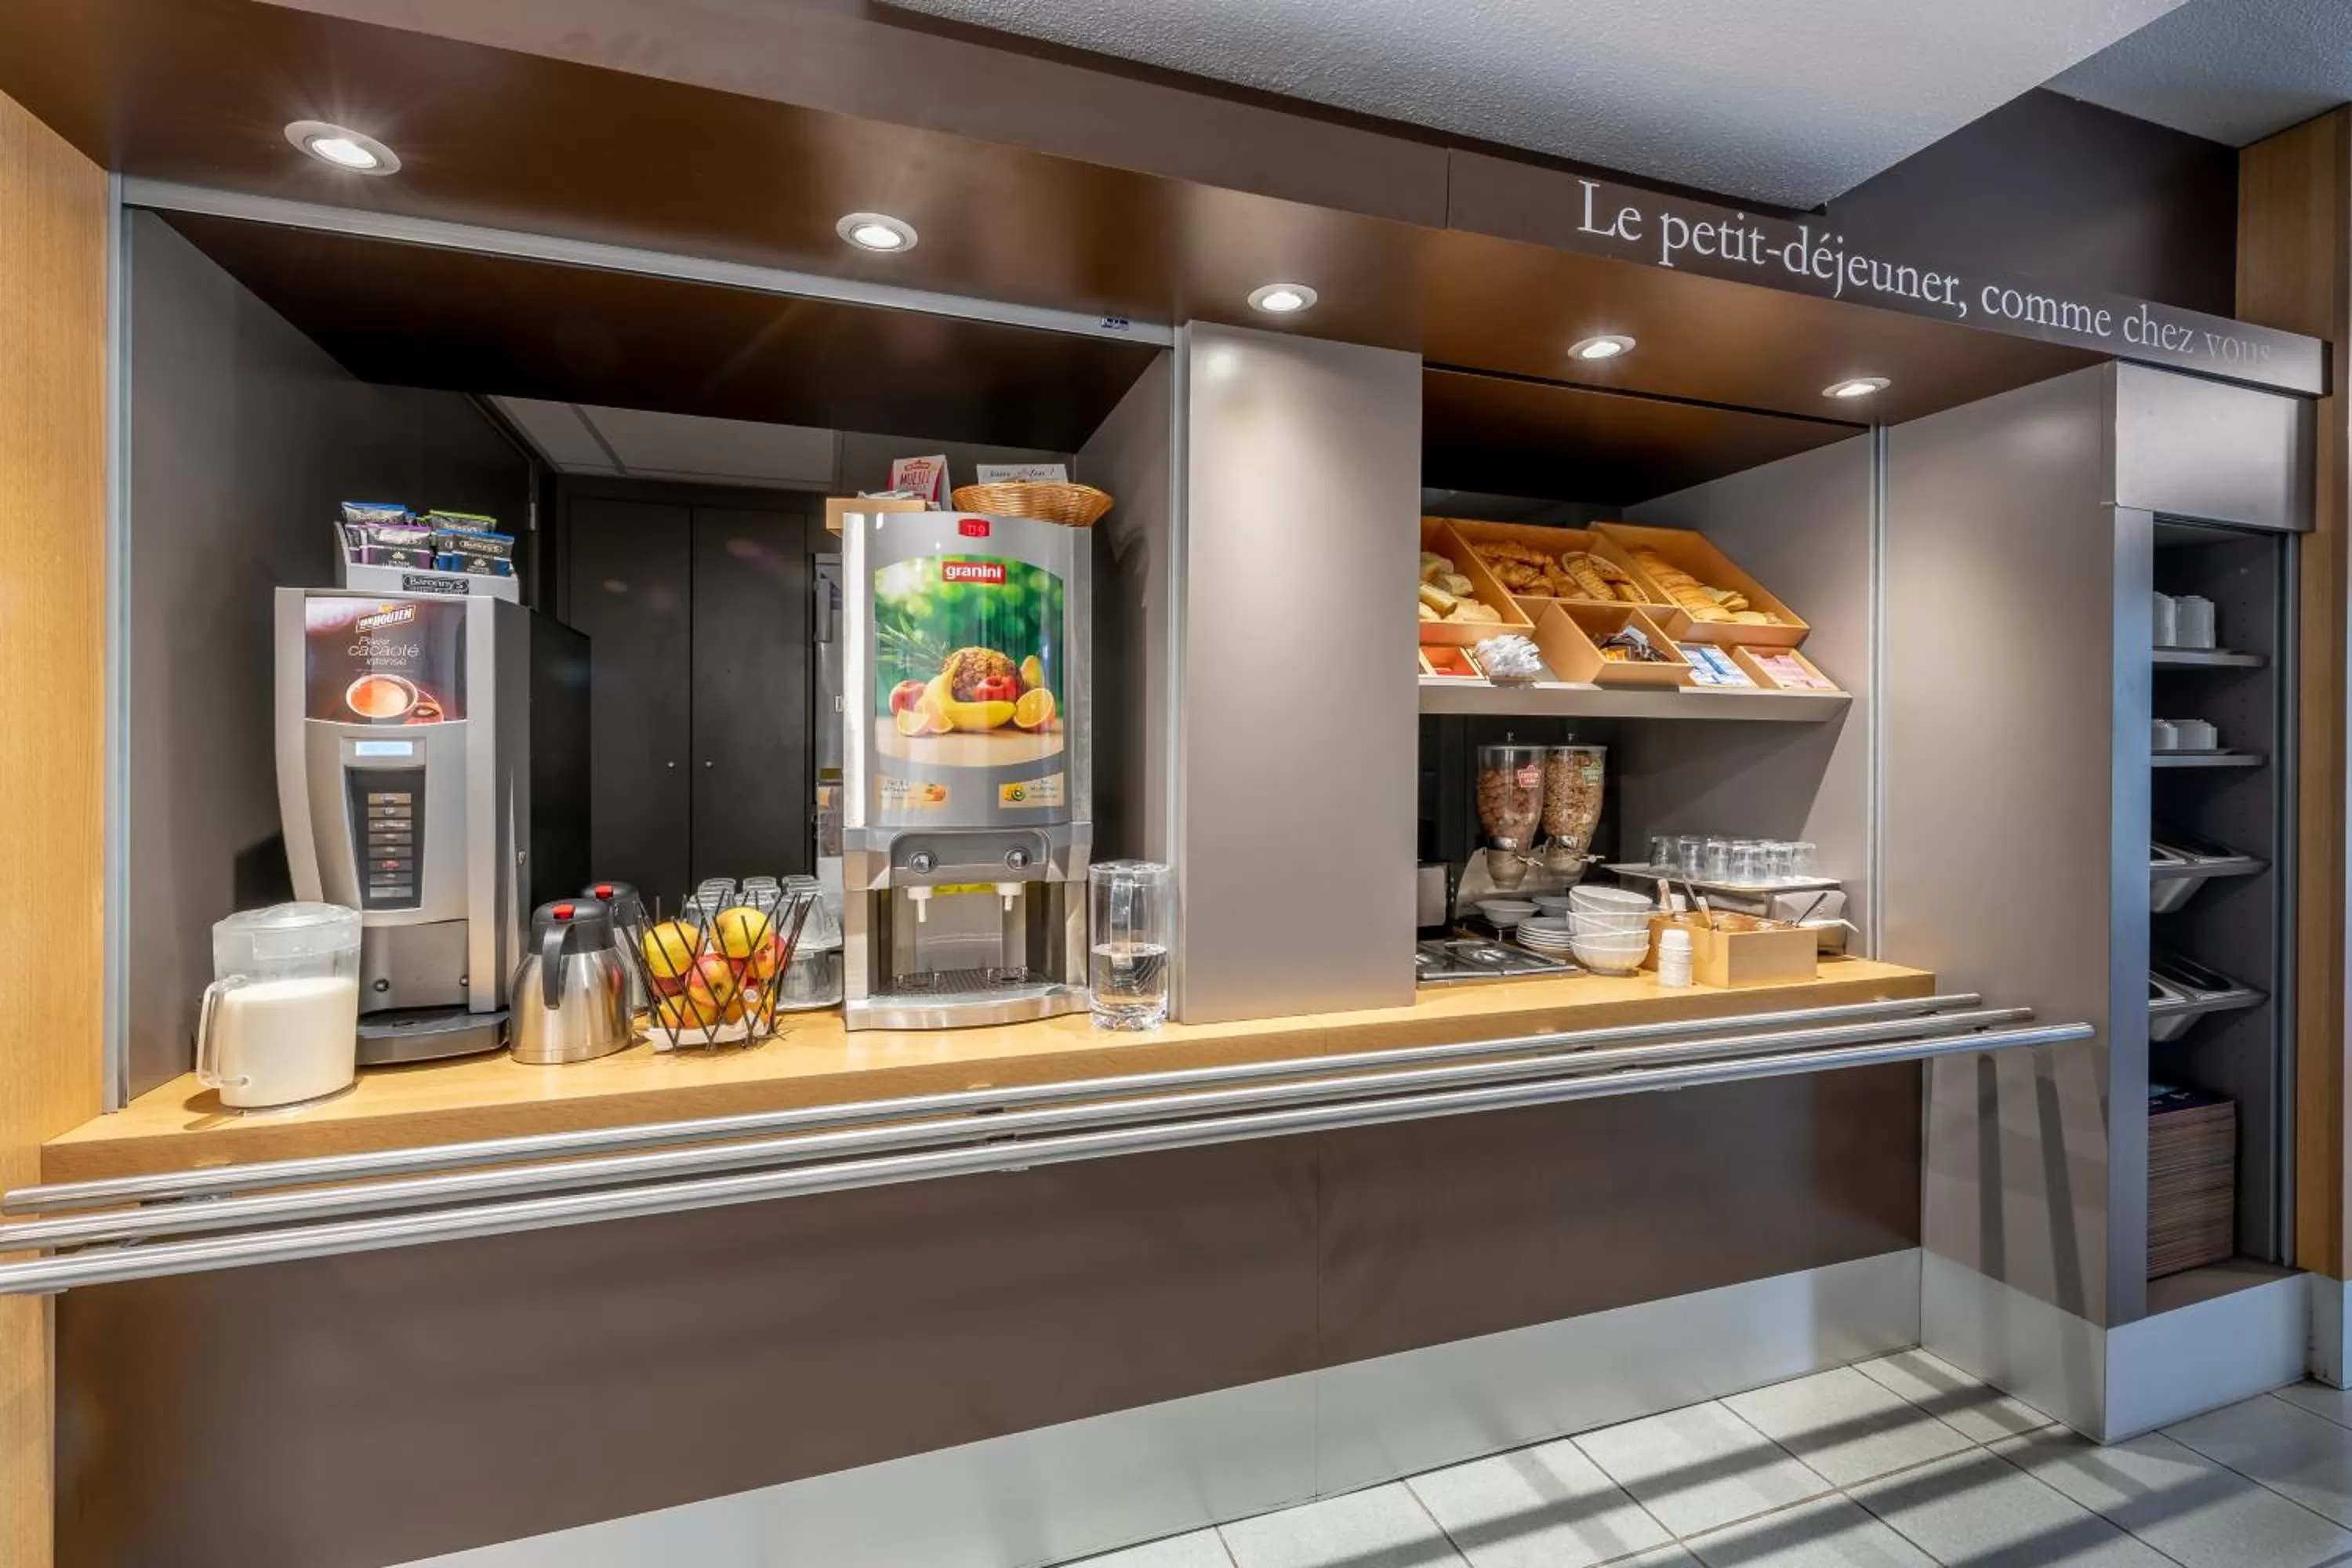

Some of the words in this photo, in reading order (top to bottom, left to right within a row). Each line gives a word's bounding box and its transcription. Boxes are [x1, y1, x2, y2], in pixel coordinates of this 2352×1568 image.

[1577, 180, 1642, 241] Le
[1658, 212, 1968, 318] petit-déjeuner,
[1981, 285, 2111, 336] comme
[2123, 304, 2195, 354] chez
[2203, 332, 2271, 365] vous
[946, 564, 1002, 579] granini
[373, 608, 413, 626] HOUTEN
